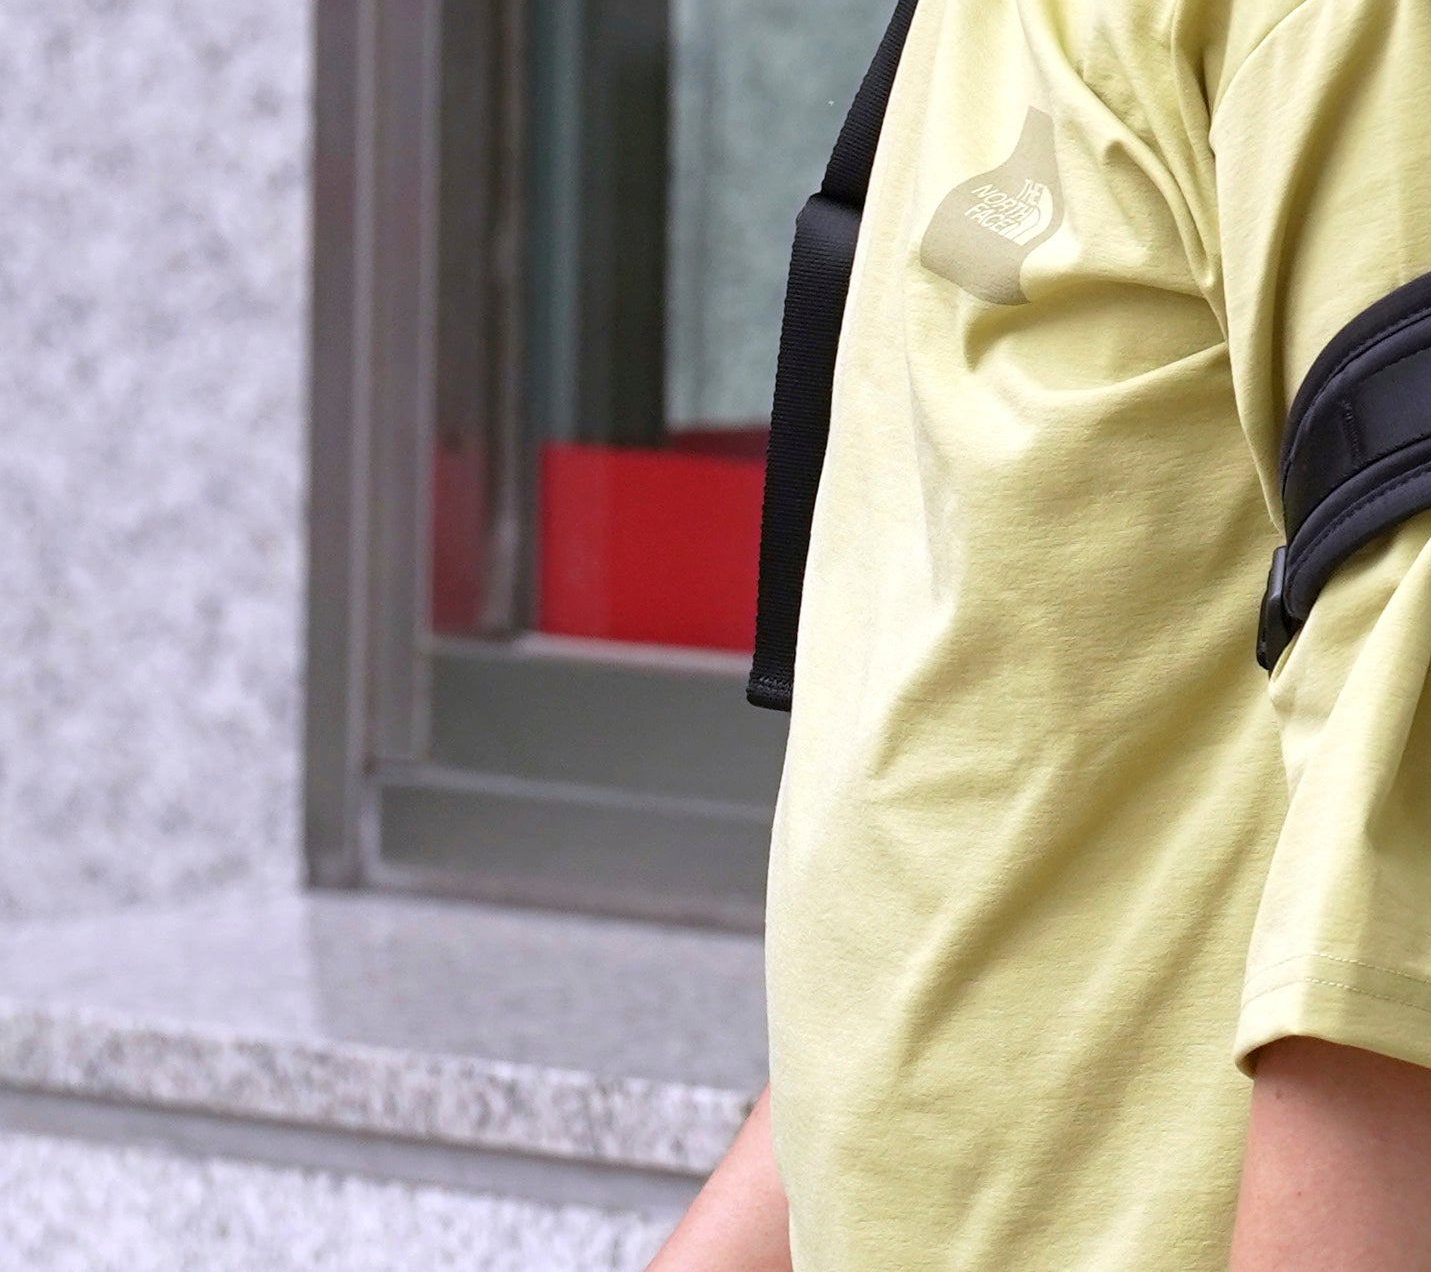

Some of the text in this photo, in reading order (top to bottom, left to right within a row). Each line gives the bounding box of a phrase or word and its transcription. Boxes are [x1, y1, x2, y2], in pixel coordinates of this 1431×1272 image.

[970, 183, 1034, 223] NORTH
[1015, 178, 1044, 207] THE
[964, 202, 1018, 233] FACE
